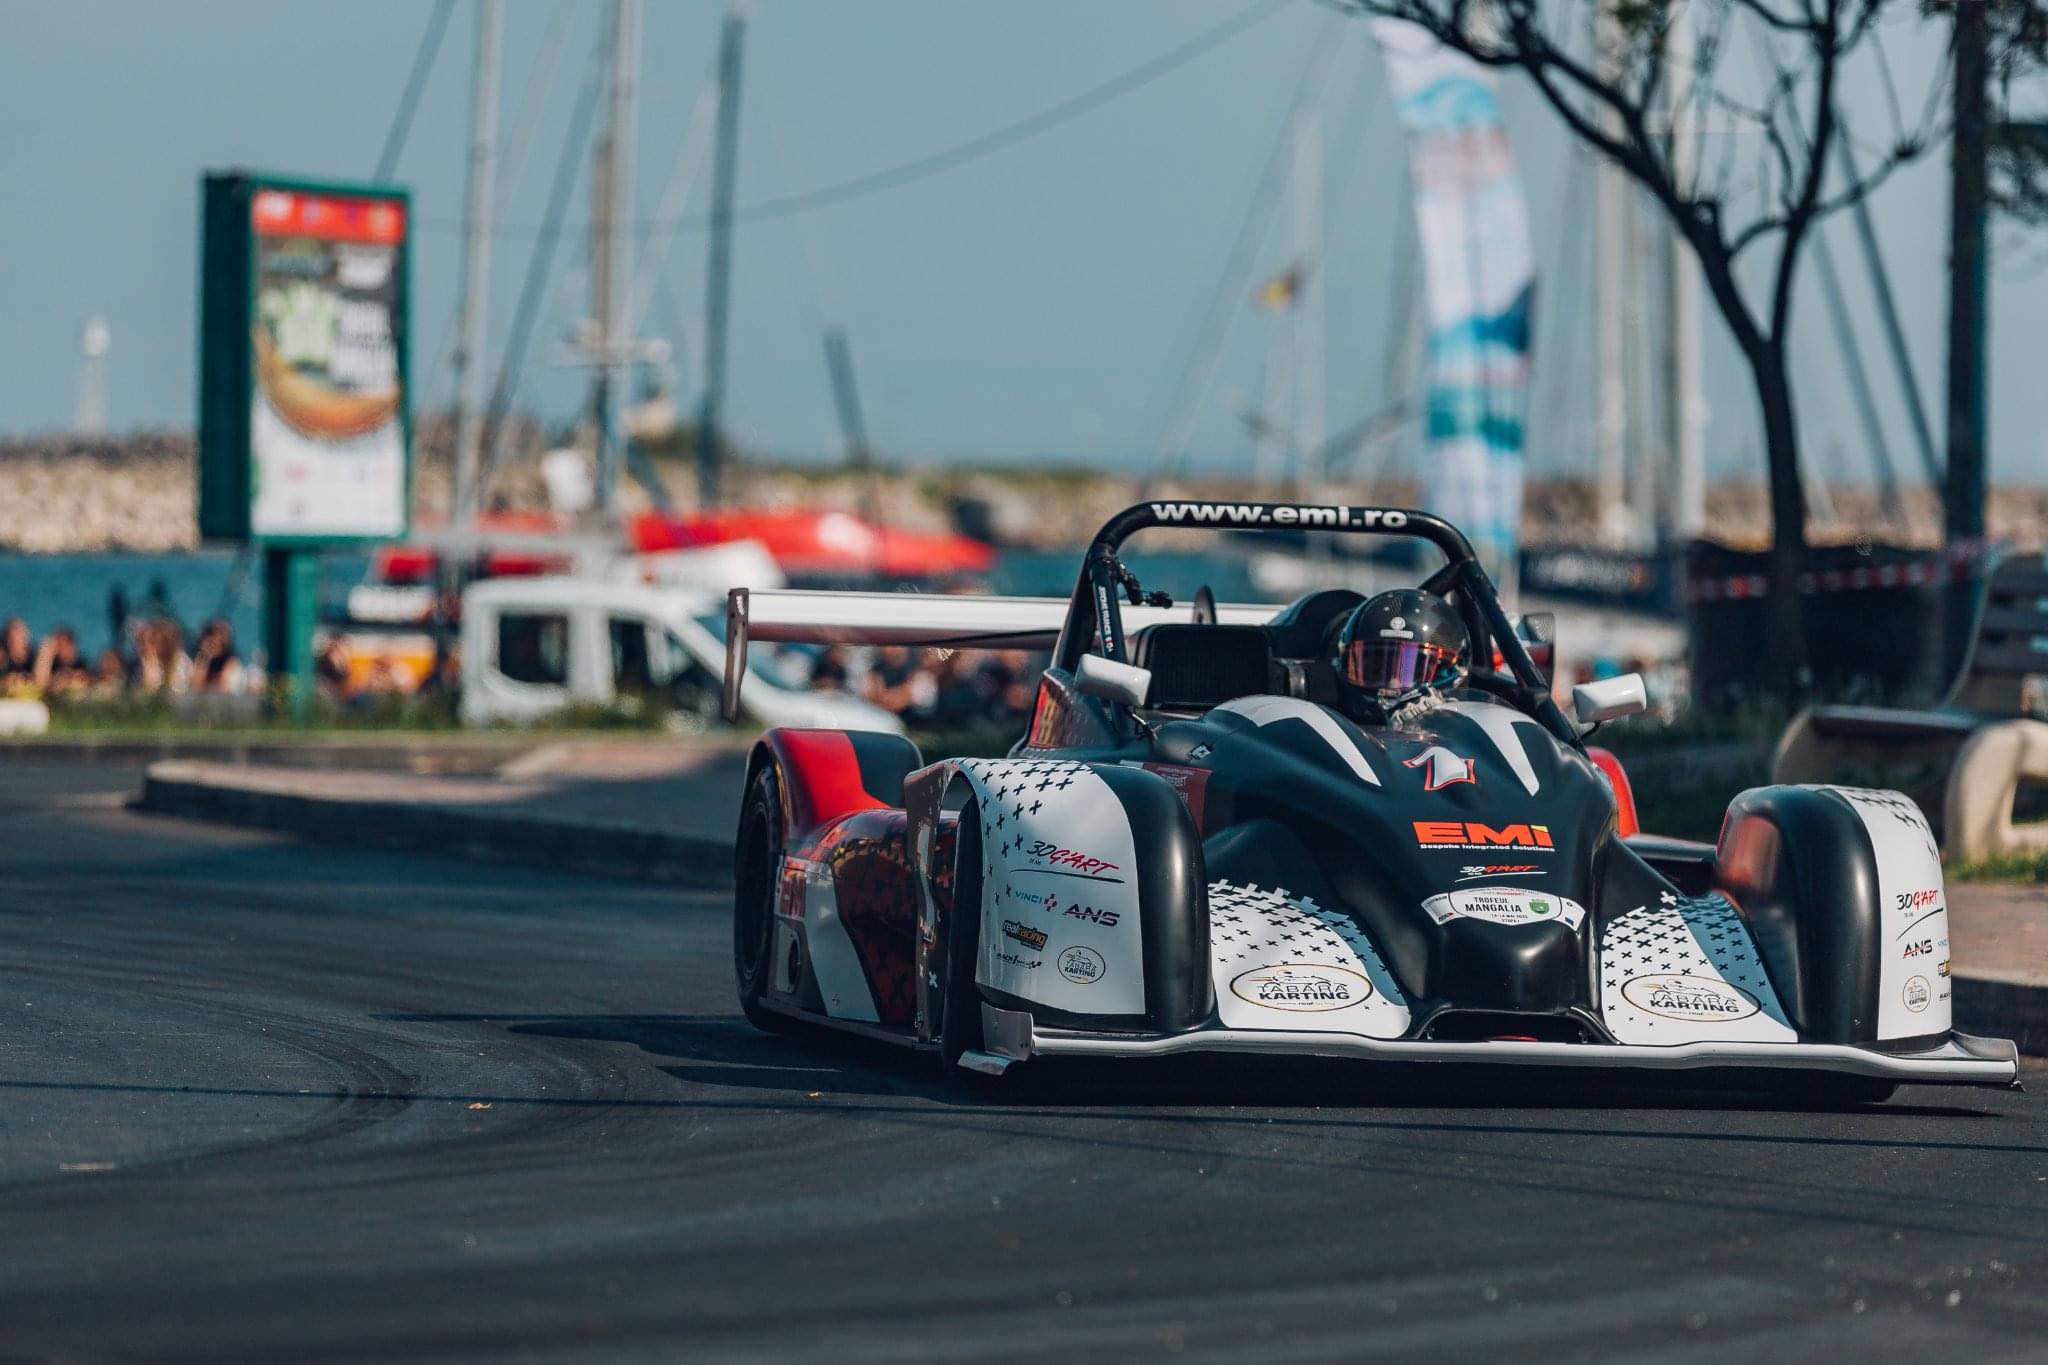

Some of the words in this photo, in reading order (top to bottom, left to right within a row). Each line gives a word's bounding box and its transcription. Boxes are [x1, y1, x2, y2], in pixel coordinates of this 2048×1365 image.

[1151, 503, 1408, 528] www.emi.ro
[1403, 746, 1476, 790] 1
[1015, 891, 1043, 904] VINCI
[1473, 896, 1509, 904] TROFEUL
[1464, 903, 1522, 913] MANGALIA
[1063, 903, 1121, 927] ANS
[1903, 939, 1933, 959] ANS
[1064, 966, 1096, 977] KARTING
[1258, 992, 1351, 1000] KARTING
[1649, 1000, 1740, 1013] KARTING
